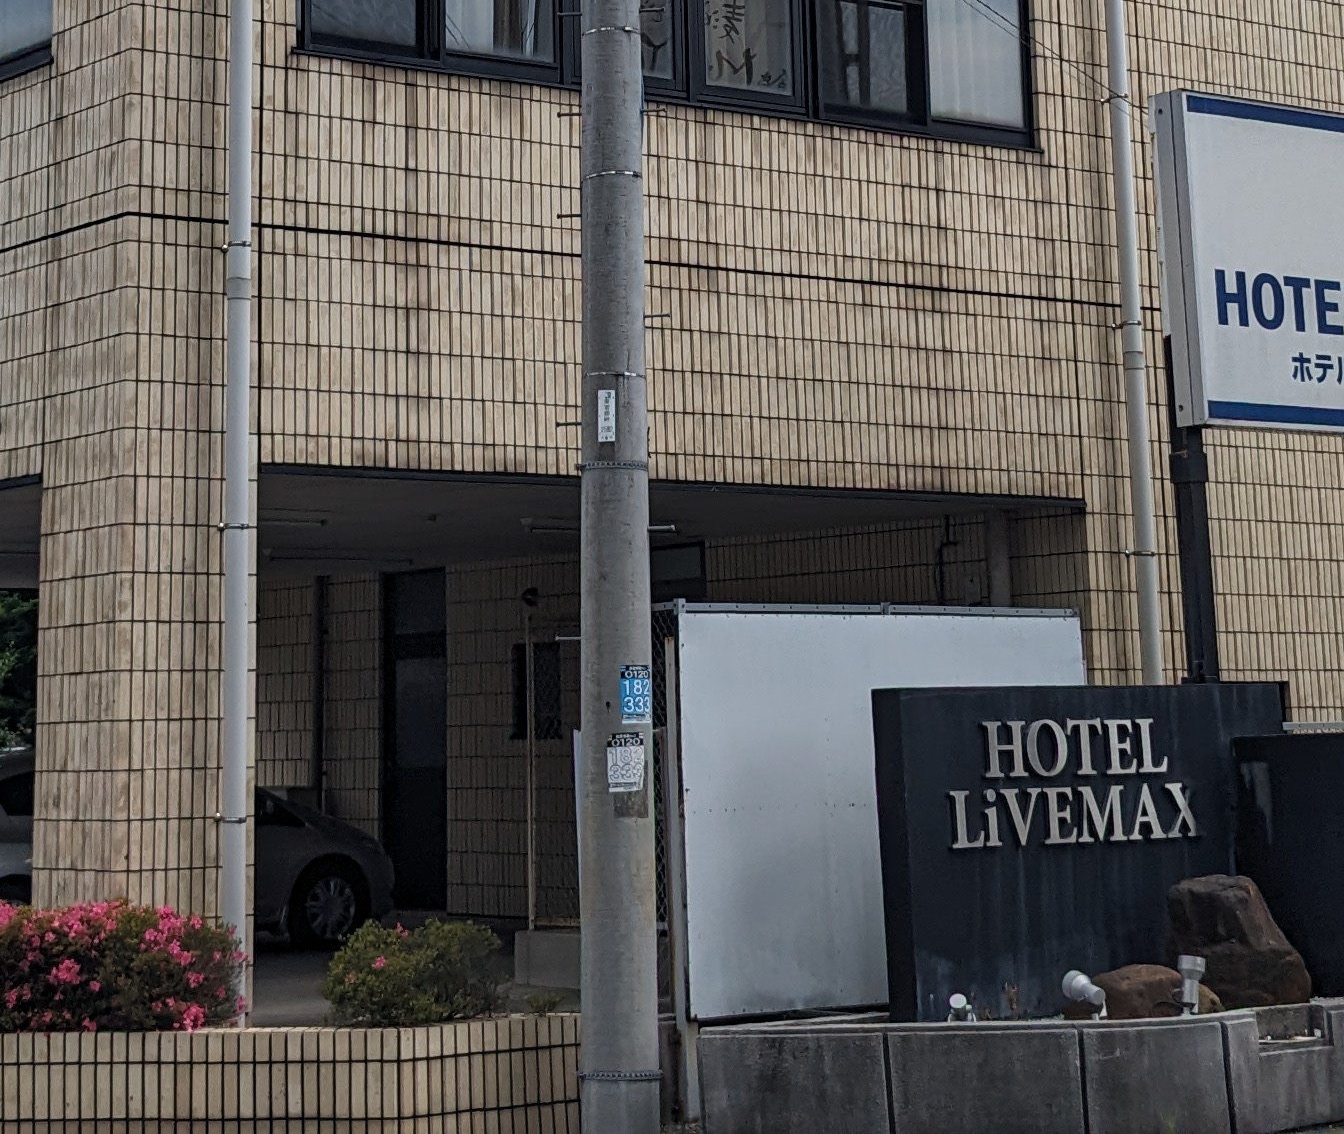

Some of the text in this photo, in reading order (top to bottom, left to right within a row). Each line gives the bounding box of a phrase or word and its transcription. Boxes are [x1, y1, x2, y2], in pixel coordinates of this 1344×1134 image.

[622, 679, 650, 696] 182
[623, 696, 650, 712] 333
[611, 737, 641, 747] 0120
[982, 718, 1169, 778] HOTEL
[949, 782, 1200, 849] LiVEMAX
